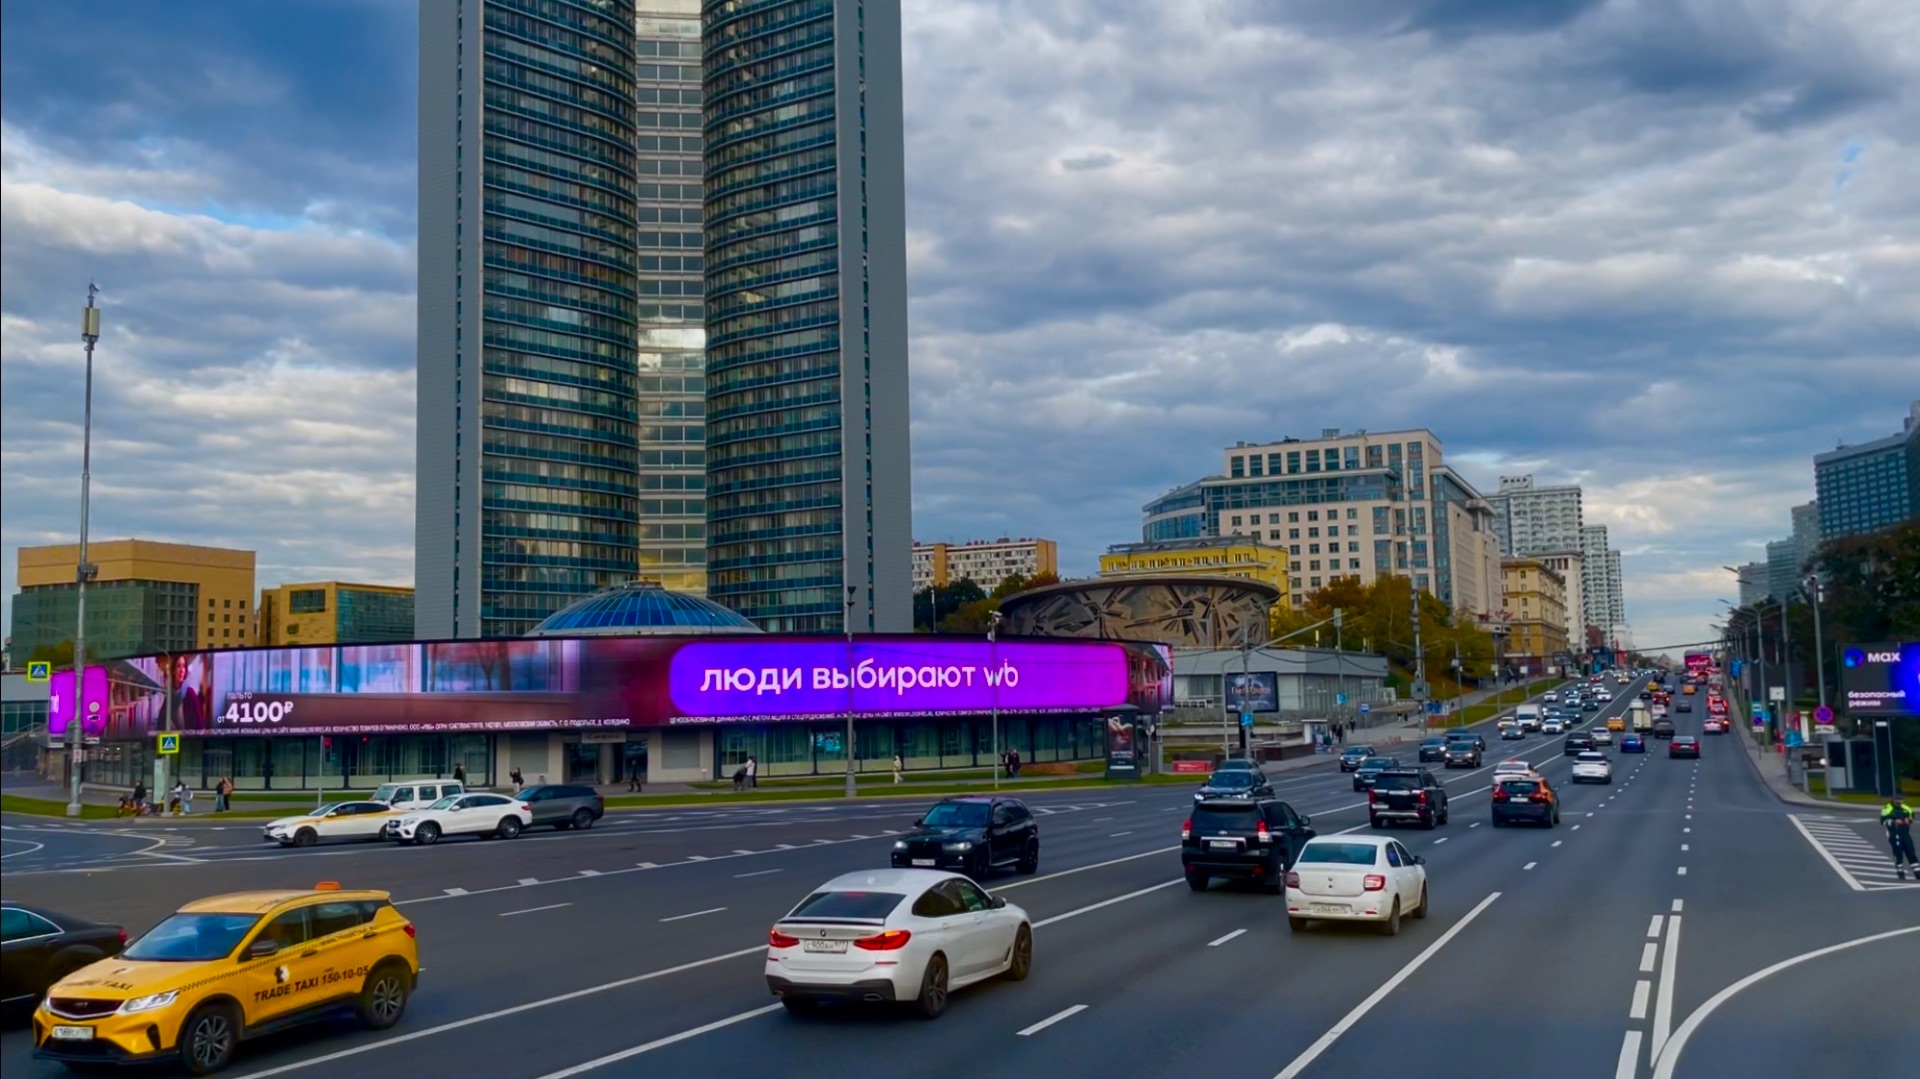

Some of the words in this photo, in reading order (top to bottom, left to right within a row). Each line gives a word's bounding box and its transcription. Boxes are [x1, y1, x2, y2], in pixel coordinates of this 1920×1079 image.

[700, 667, 802, 695] люди
[812, 658, 975, 696] выбирают
[983, 658, 1018, 688] wb
[227, 692, 252, 700] пальто
[1847, 690, 1906, 698] безопасный
[1848, 700, 1881, 708] режим
[217, 716, 226, 724] от
[254, 983, 291, 1003] TRADE
[294, 975, 319, 992] TAXI
[322, 965, 369, 984] 150-10-05
